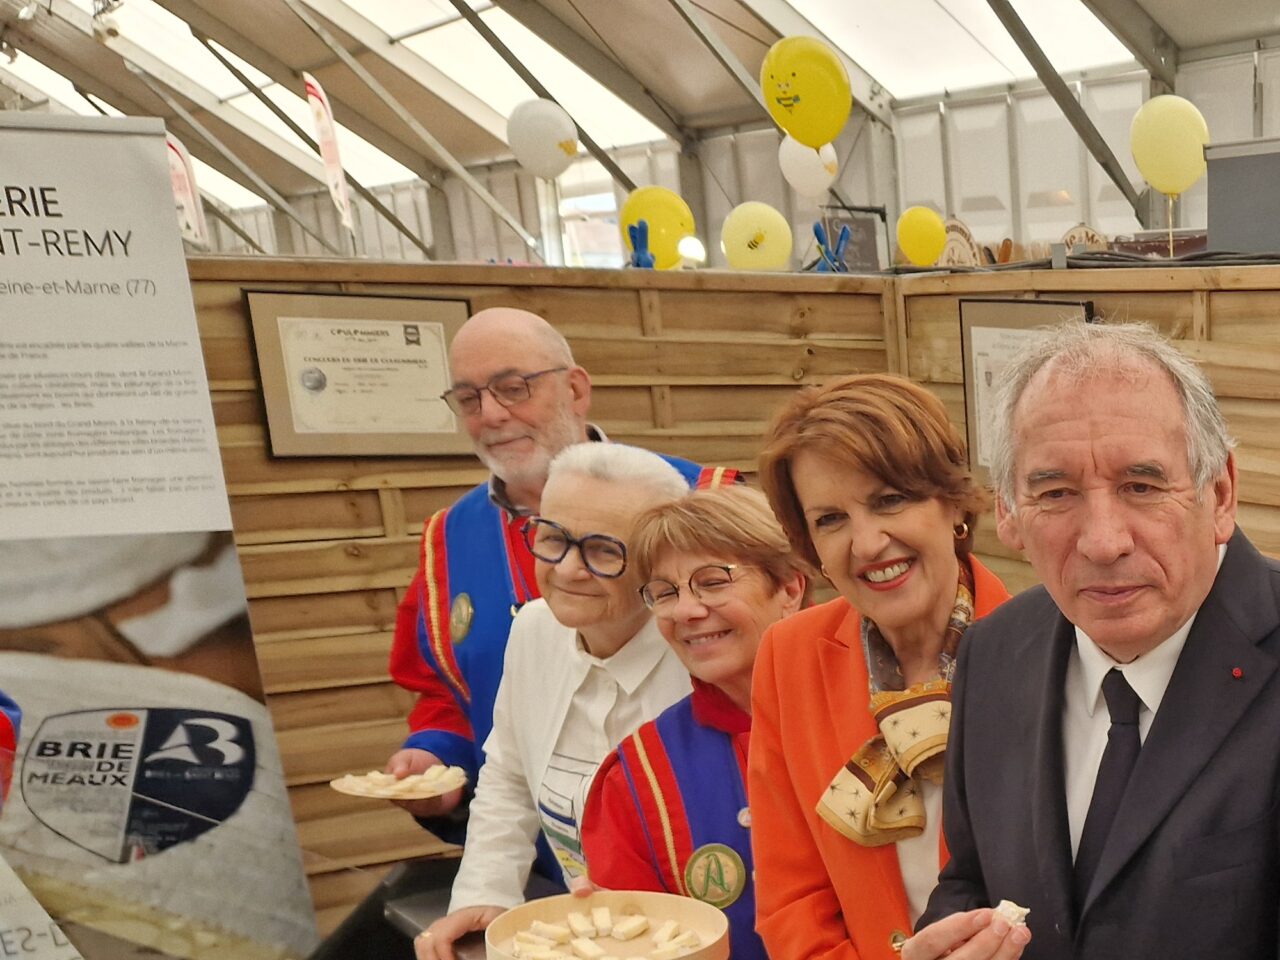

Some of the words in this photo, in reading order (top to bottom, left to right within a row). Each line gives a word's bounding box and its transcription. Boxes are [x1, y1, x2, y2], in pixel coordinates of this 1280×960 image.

[0, 186, 63, 217] RIE
[126, 279, 156, 297] (77)
[36, 741, 135, 760] BRIE
[96, 761, 130, 773] DE
[27, 772, 127, 787] MEAUX
